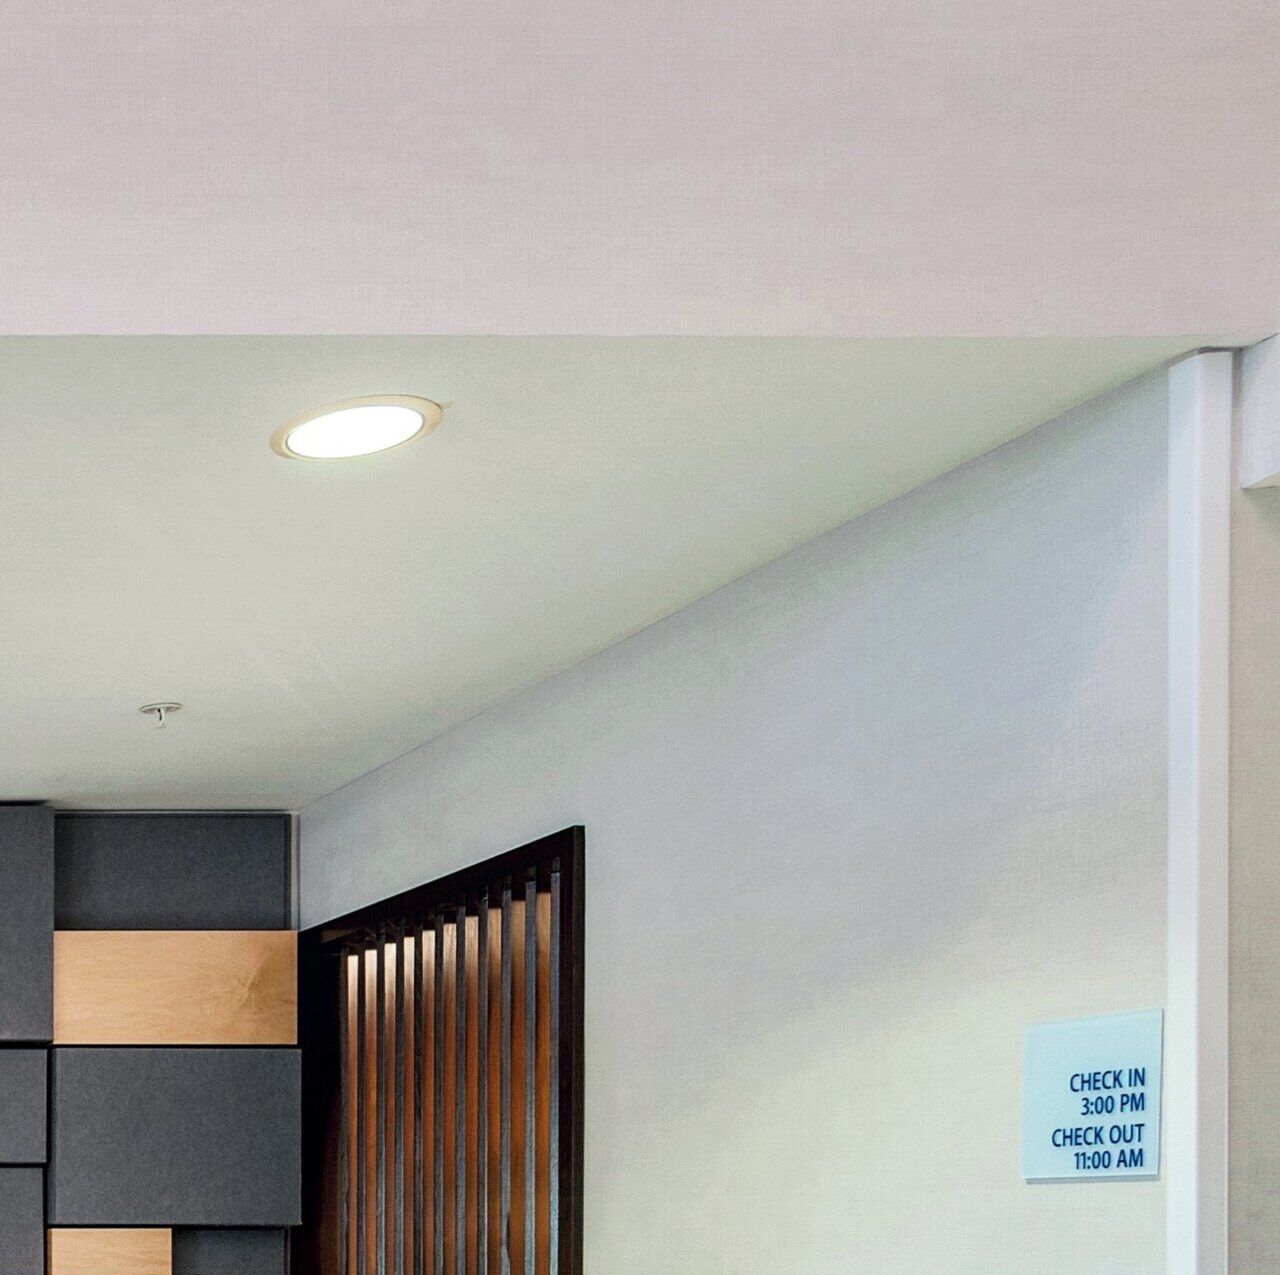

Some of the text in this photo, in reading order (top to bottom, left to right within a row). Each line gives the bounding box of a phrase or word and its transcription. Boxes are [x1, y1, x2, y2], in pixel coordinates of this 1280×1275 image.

[1069, 1067, 1146, 1092] CHECK IN
[1081, 1092, 1145, 1116] 3:00 PM
[1051, 1123, 1145, 1147] CHECK OUT
[1074, 1148, 1143, 1170] 11:00 AM
